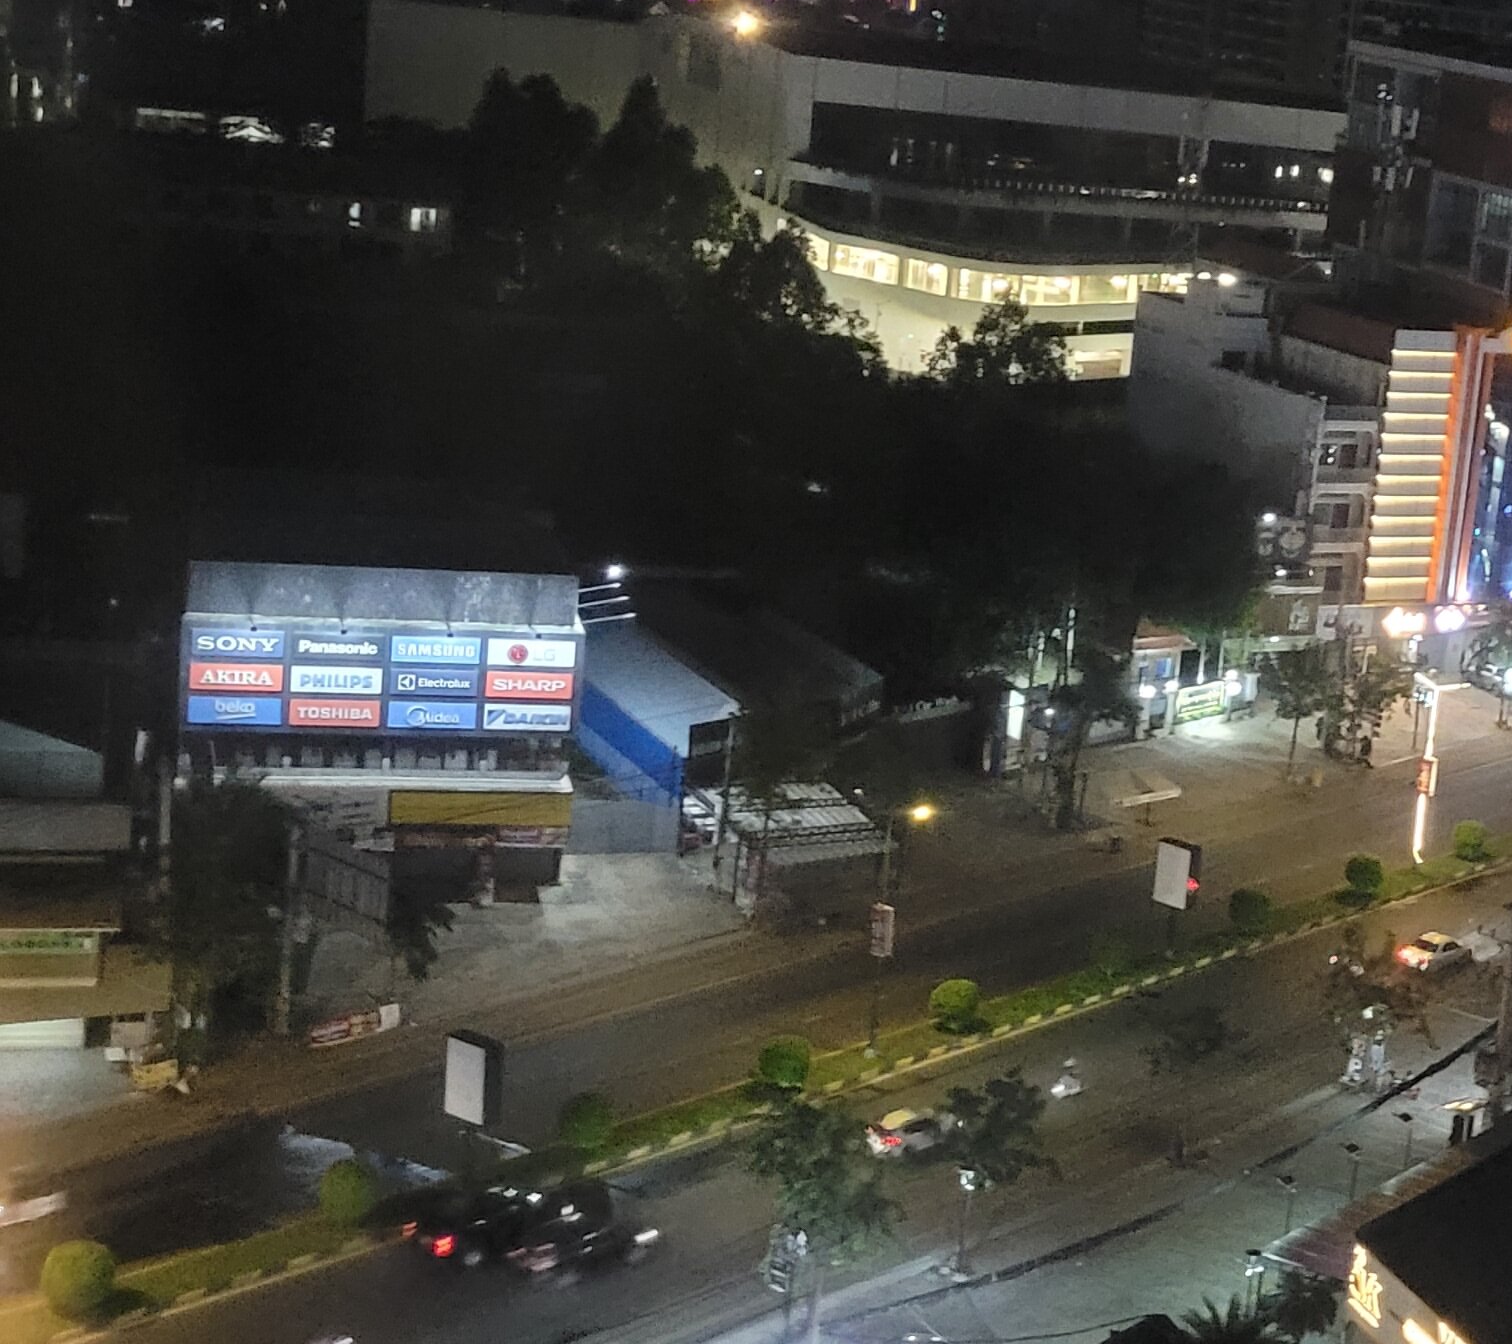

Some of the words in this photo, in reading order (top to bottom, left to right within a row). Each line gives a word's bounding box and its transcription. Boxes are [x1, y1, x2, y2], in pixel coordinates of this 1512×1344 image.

[196, 635, 280, 652] SONY
[298, 639, 378, 655] Panasonic
[397, 642, 476, 658] SAMSUNG
[532, 648, 557, 662] LG
[199, 669, 273, 686] AKIRA
[299, 673, 373, 689] PHILIPS
[417, 677, 471, 689] Electrolux
[492, 678, 566, 692] SHARP
[214, 699, 256, 713] beko
[297, 706, 373, 720] TOSHIBA
